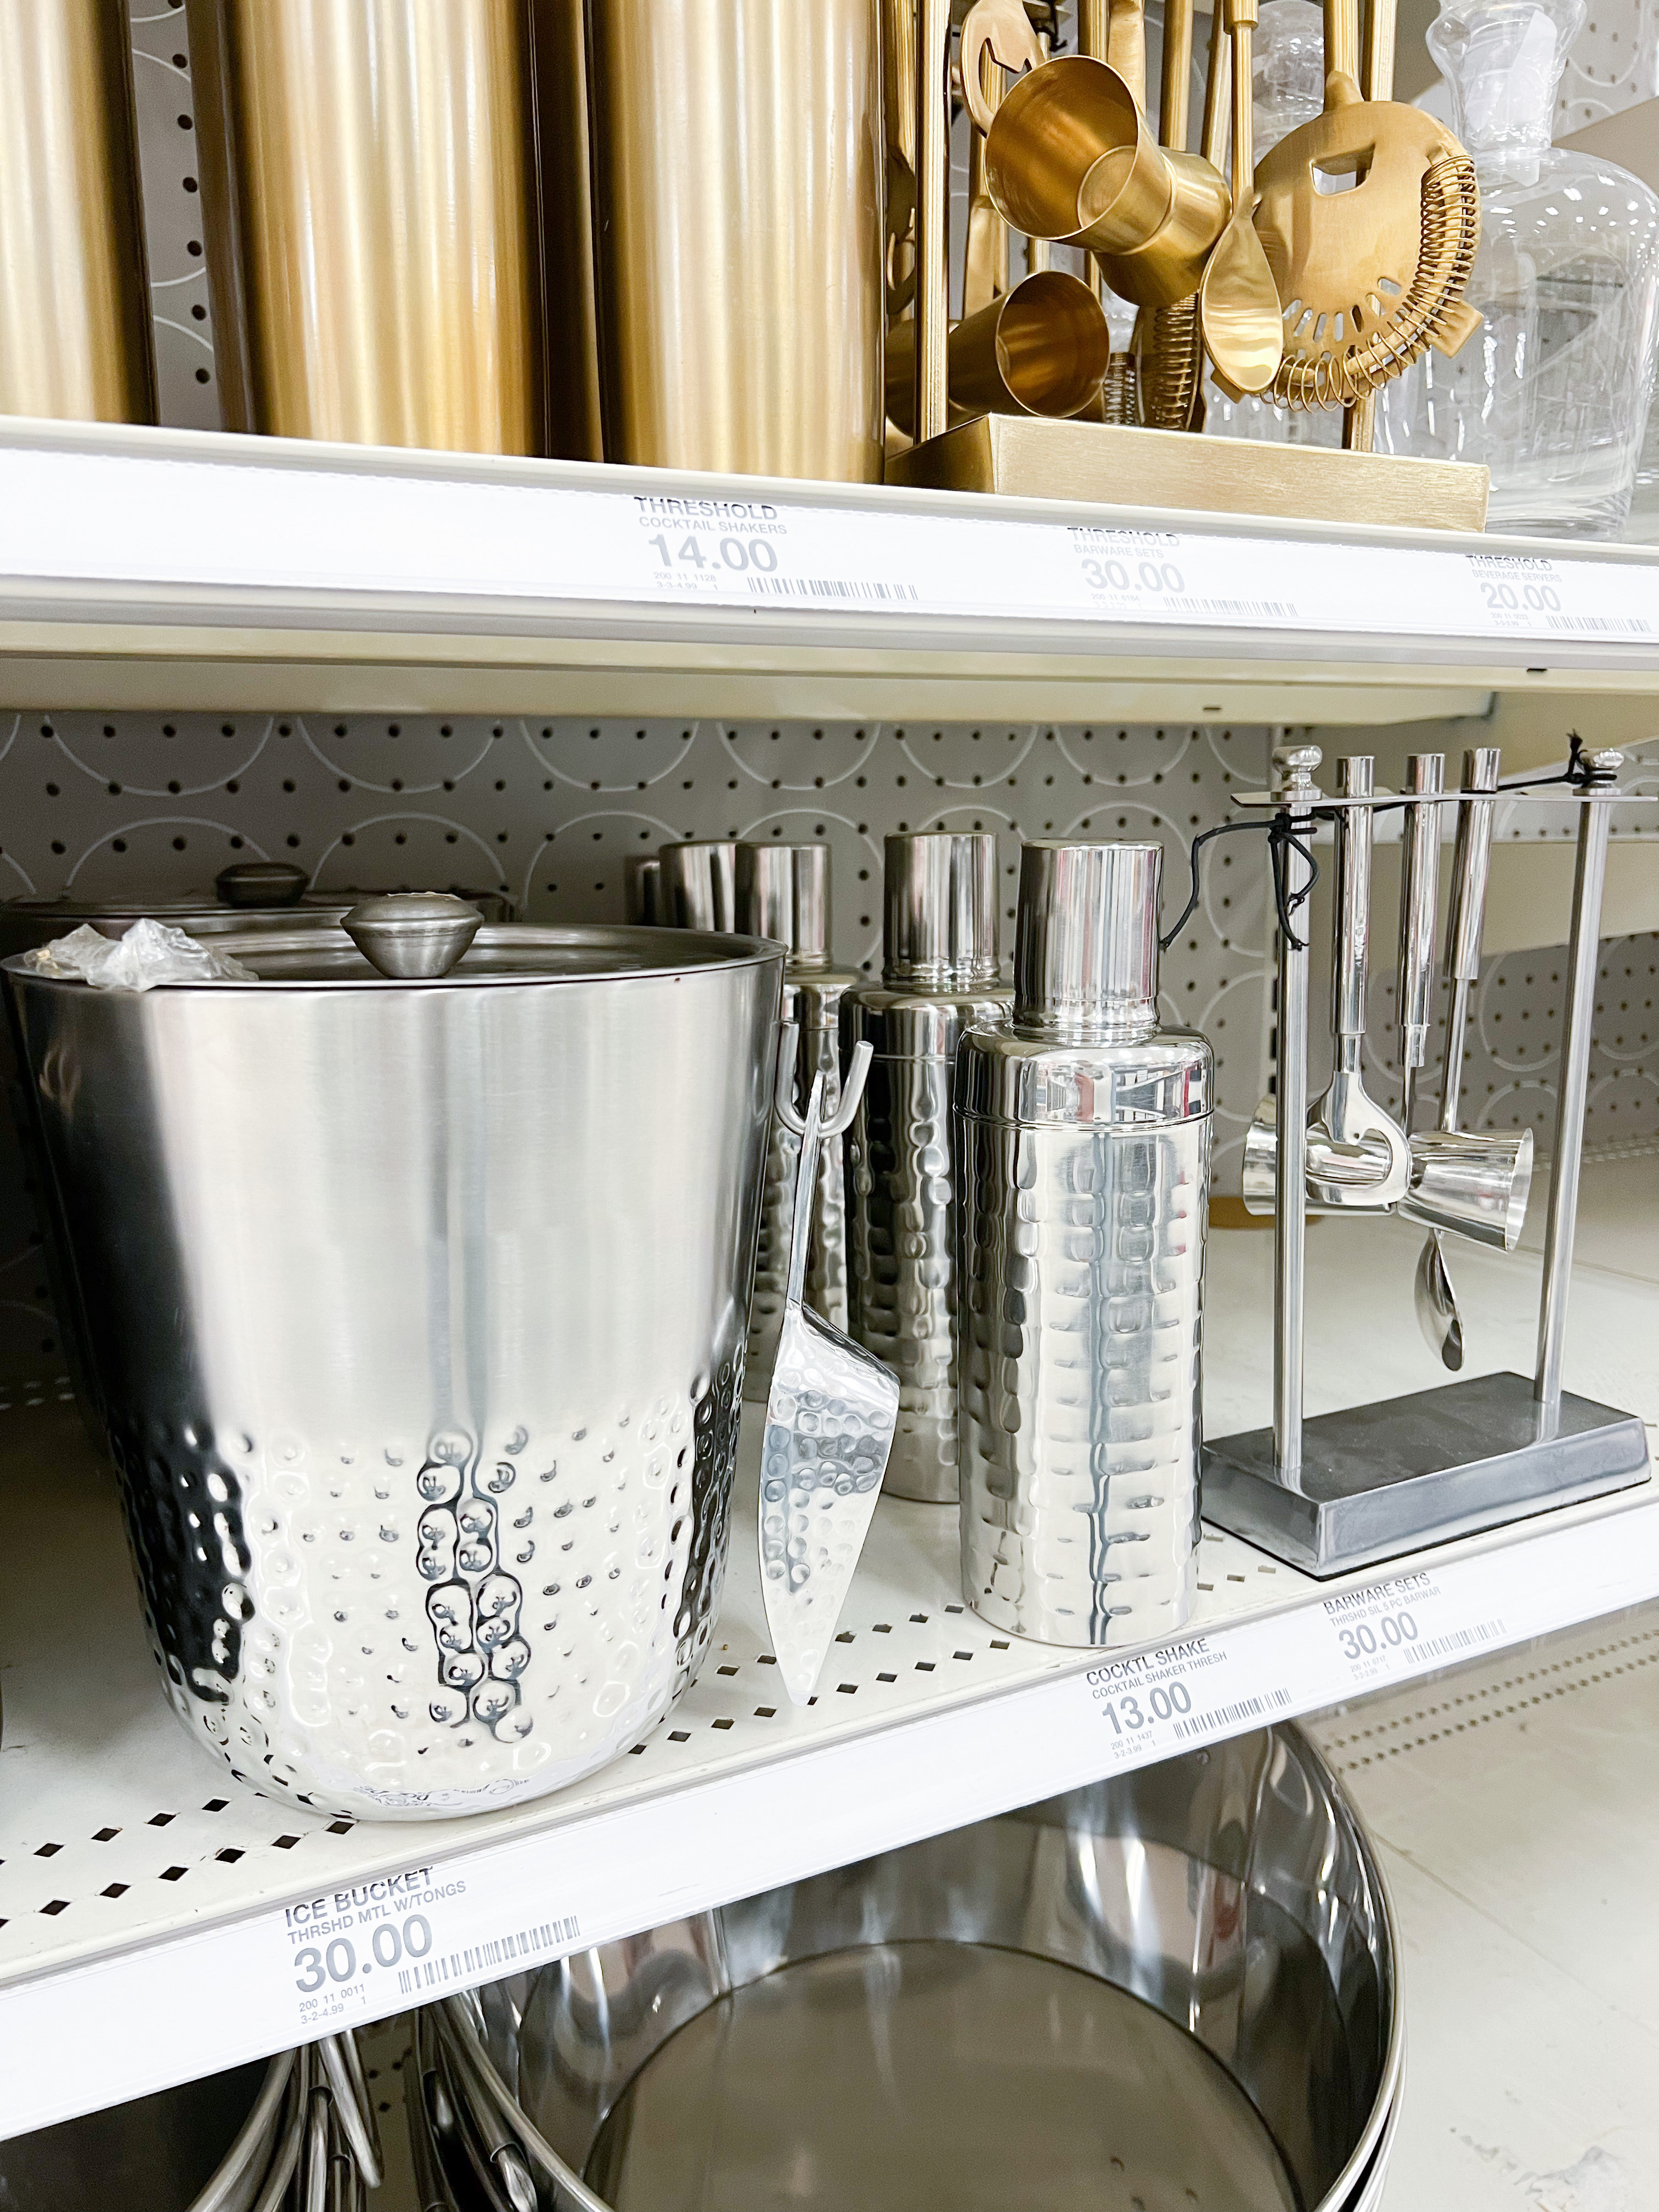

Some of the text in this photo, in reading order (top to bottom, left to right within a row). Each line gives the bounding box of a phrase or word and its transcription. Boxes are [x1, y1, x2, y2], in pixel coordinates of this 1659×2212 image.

[634, 496, 777, 520] THRESHOLD
[639, 517, 787, 534] COCKTAIL SHAKERS
[648, 534, 778, 572] 14.00
[1067, 527, 1180, 547] THRESHOLD
[1074, 544, 1164, 558] BARWARE SETS
[1081, 558, 1185, 593] 30.00
[1465, 555, 1553, 571] THRESHOLD
[1471, 569, 1562, 582] BEVERAGE SERVERS
[1480, 582, 1561, 612] 20.00
[1323, 1572, 1431, 1615] BARWARE SETS
[1330, 1587, 1442, 1627] THRSHD SIL 5 PC BARWAR
[1339, 1611, 1418, 1660] 30.00
[1086, 1638, 1210, 1686] COCKTL SHAKE
[1092, 1651, 1228, 1700] COCKTAIL SHAKER THRESH
[1102, 1681, 1192, 1735] 13.00
[1110, 1730, 1152, 1750] 200 11 1437
[285, 1866, 433, 1928] ICE BUCKET
[287, 1880, 467, 1945] THRSHD MTL W/TONGS
[294, 1914, 432, 1993] 30.00
[299, 1984, 365, 2013] 200 11 0011
[301, 1996, 366, 2024] 3-2-4.99 1
